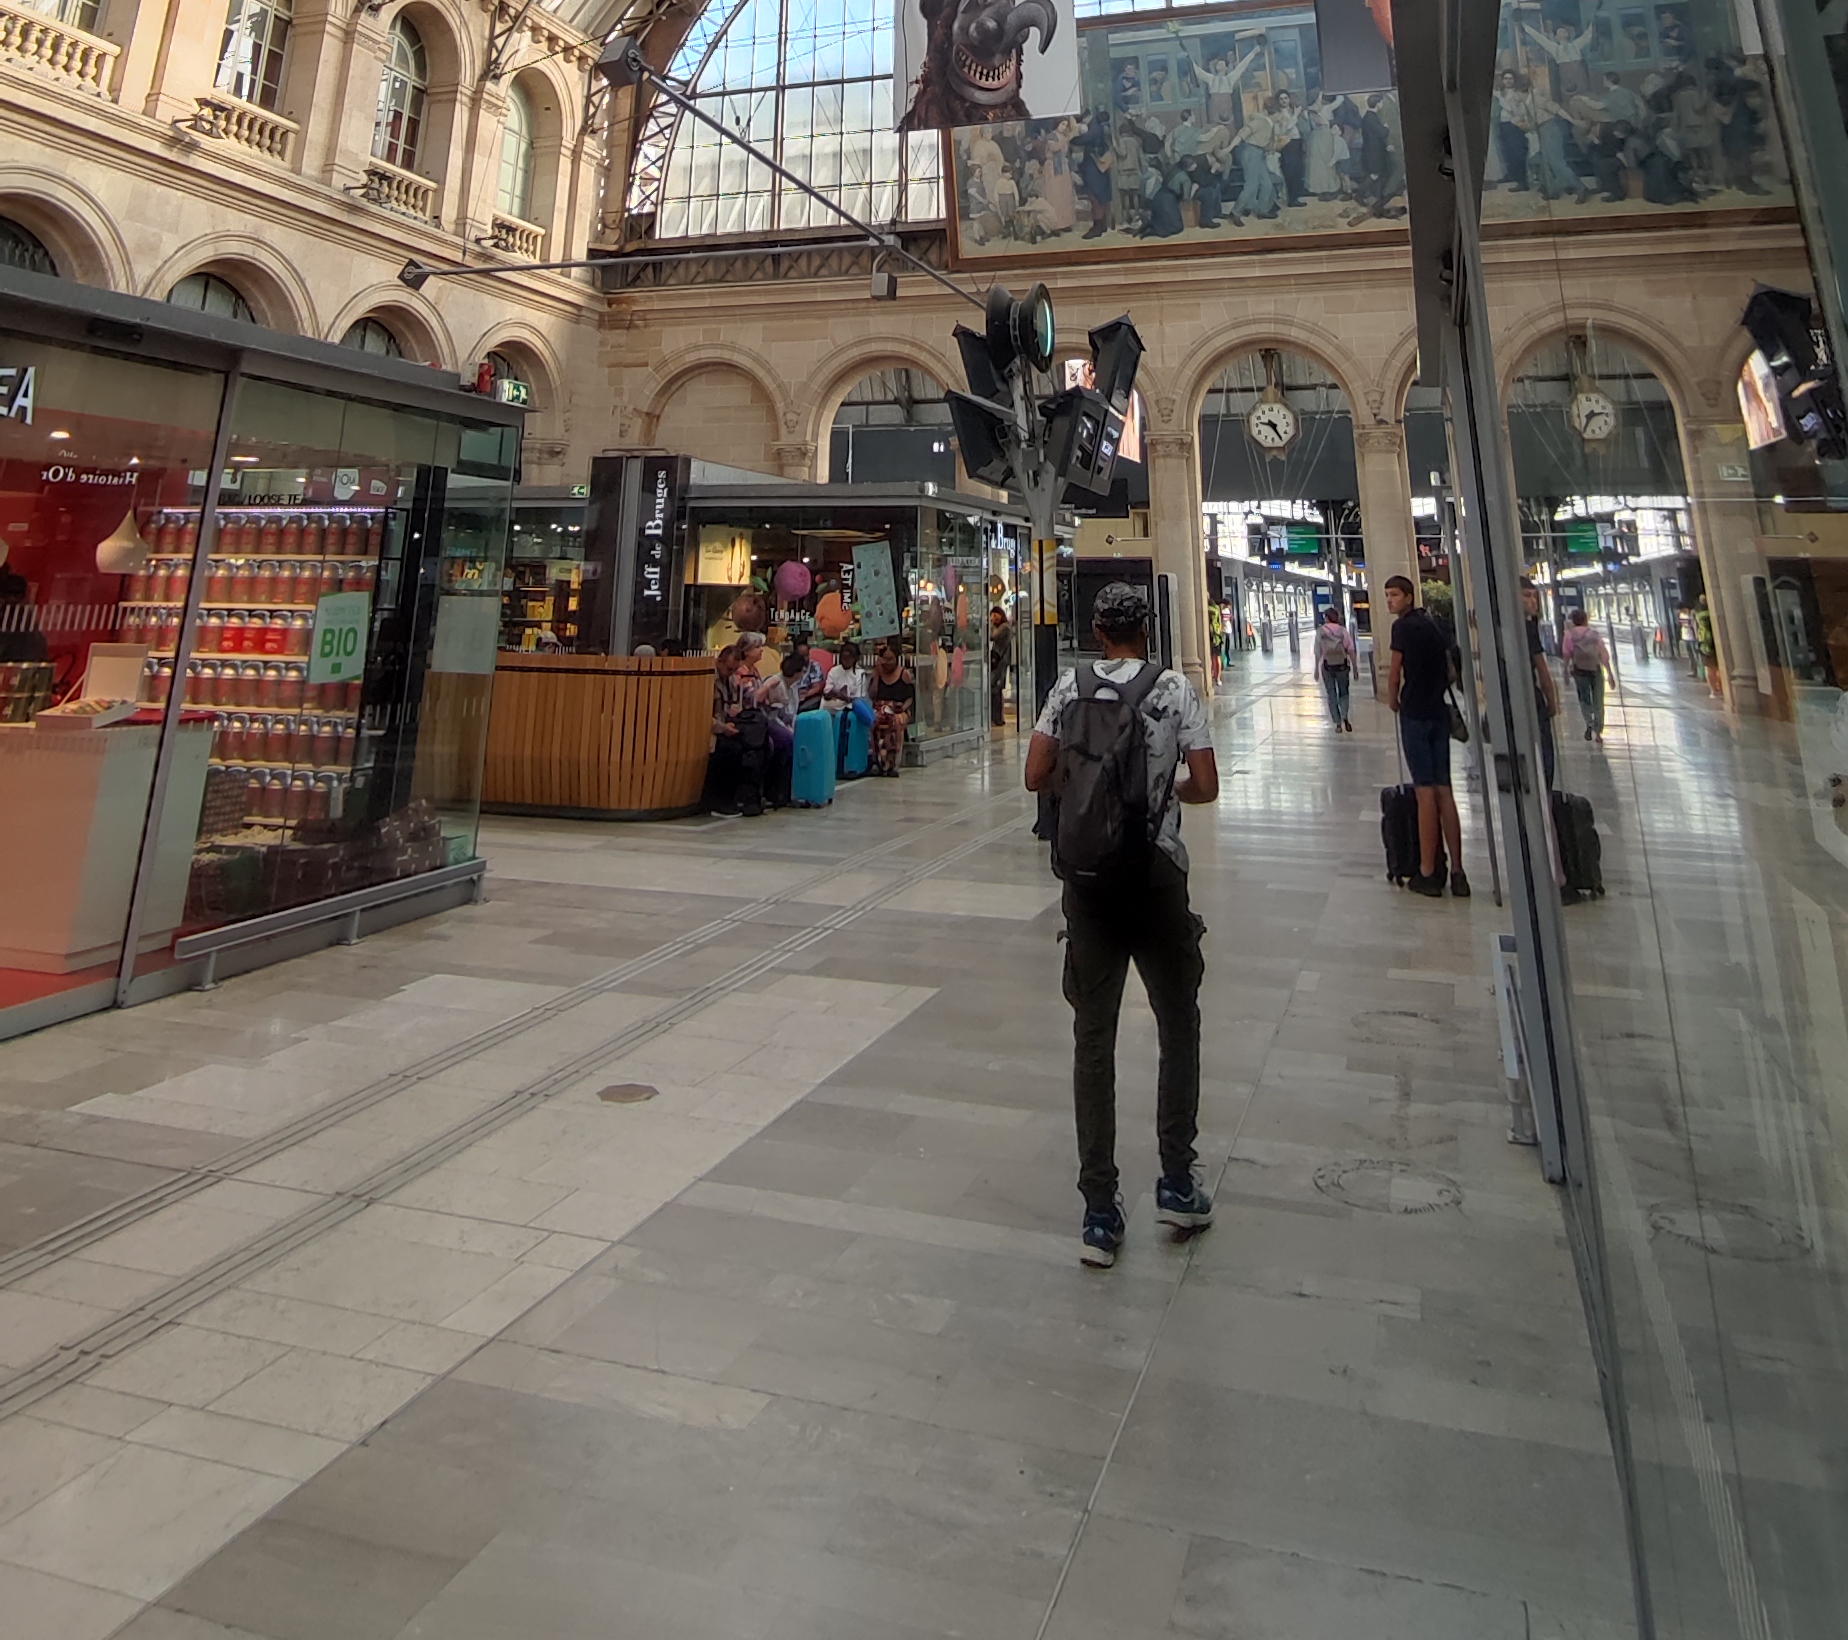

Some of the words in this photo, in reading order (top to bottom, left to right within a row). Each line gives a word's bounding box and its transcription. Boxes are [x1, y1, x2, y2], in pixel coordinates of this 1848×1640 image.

[248, 493, 285, 506] LOOSE
[644, 470, 669, 538] Bruges
[650, 542, 662, 560] de
[643, 563, 662, 602] Jeff
[769, 607, 811, 622] TENDANCE
[320, 626, 358, 659] BIO
